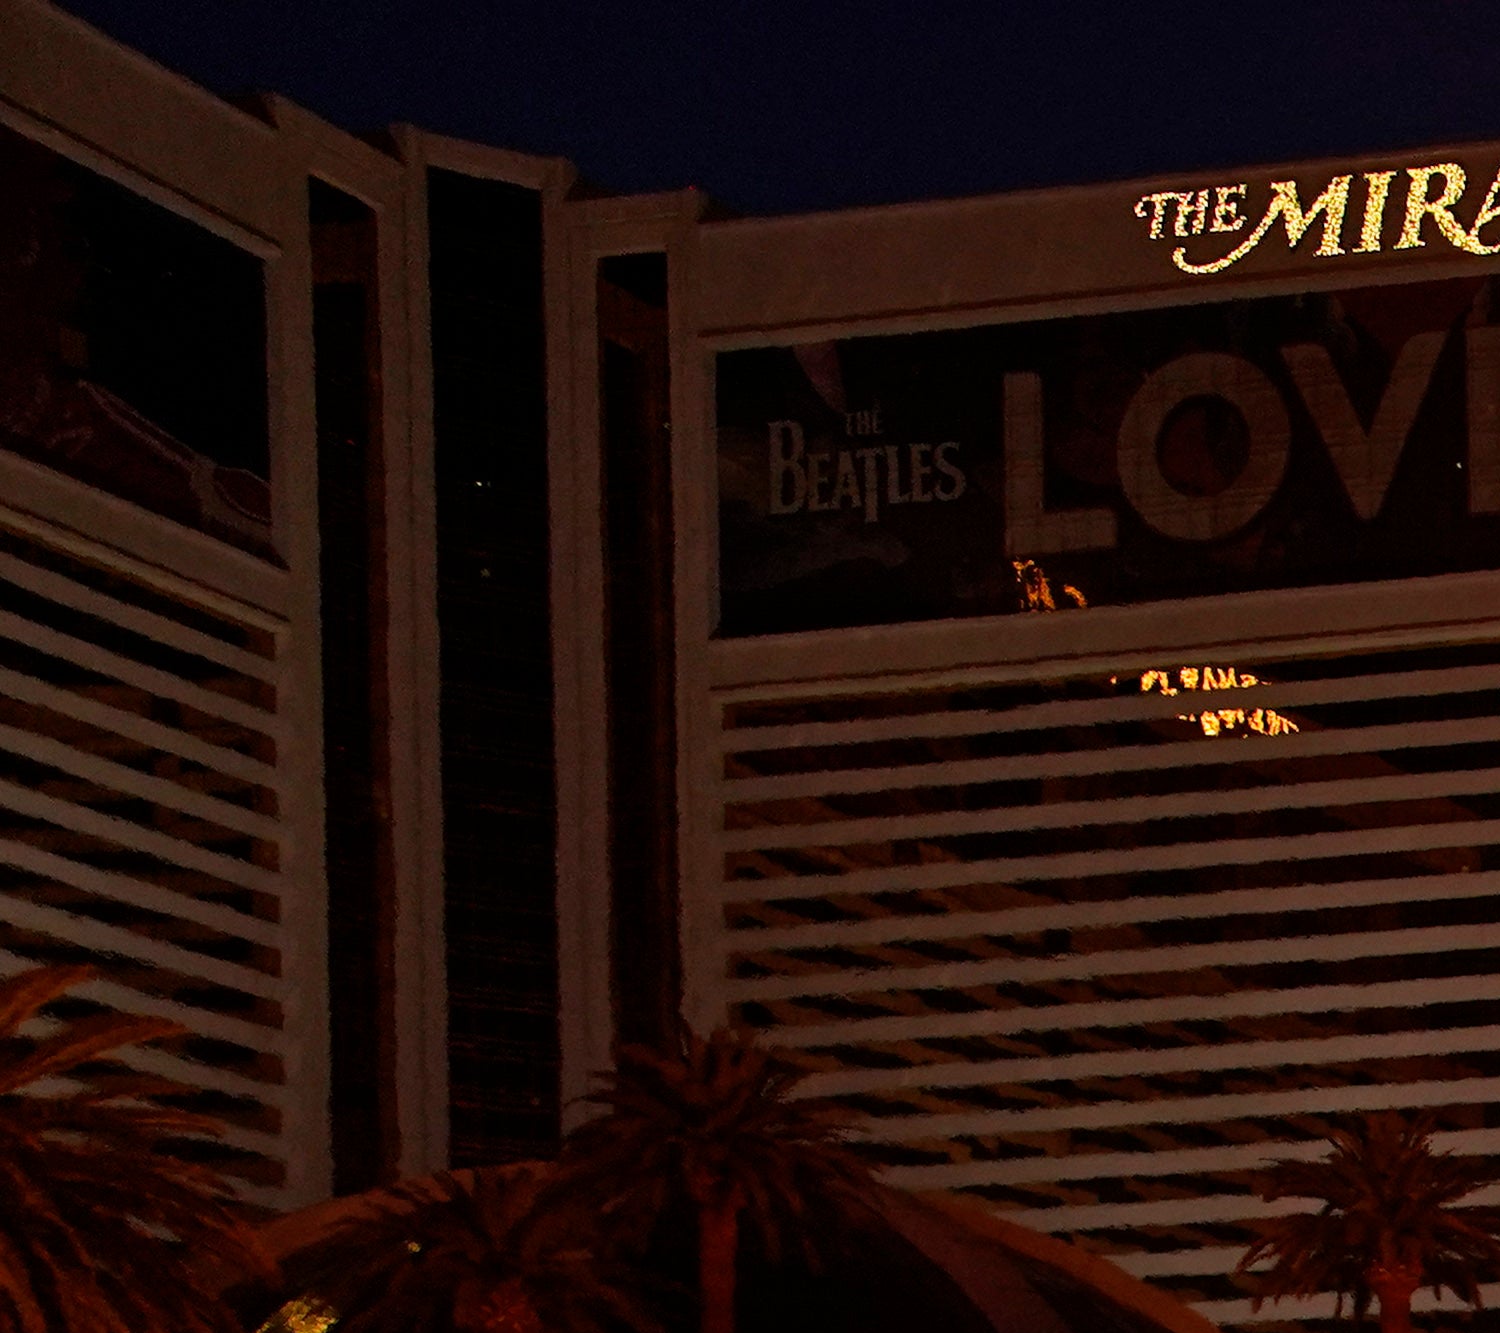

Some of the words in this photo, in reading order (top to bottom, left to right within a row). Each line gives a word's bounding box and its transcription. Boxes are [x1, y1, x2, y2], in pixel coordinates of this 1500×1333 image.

[1133, 183, 1249, 241] THE
[845, 410, 884, 437] THE
[767, 420, 968, 524] BEATLES
